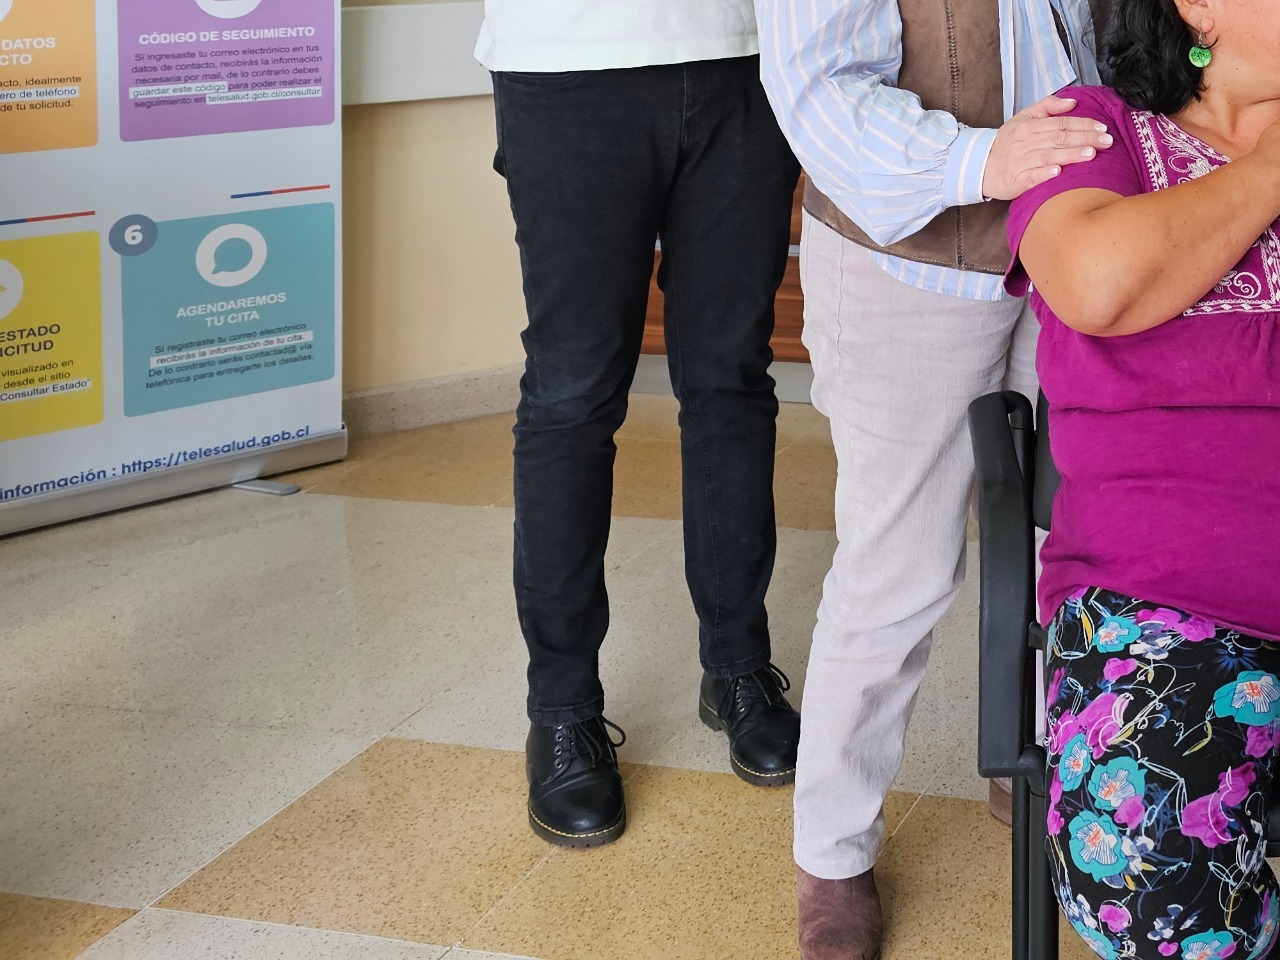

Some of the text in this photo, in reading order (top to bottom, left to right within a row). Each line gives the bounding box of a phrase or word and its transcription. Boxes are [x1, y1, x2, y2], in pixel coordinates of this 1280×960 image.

[138, 26, 315, 44] CÓDIGO DE SEGUIMIENTO
[1, 37, 56, 51] DATOS
[0, 53, 32, 66] CTO
[134, 53, 144, 61] Si
[147, 51, 196, 62] ingresaste
[210, 49, 239, 57] correo
[242, 46, 289, 55] electrónico
[131, 65, 158, 73] datos
[220, 59, 258, 68] recibirás
[272, 55, 322, 64] información
[25, 76, 82, 86] idealmente
[135, 75, 181, 85] necesaria
[184, 74, 199, 83] por
[251, 68, 289, 77] contrario
[20, 90, 32, 98] de
[36, 88, 77, 97] teléfono
[133, 87, 170, 97] guardar
[195, 84, 225, 93] código
[228, 82, 248, 91] para
[251, 80, 276, 89] poder
[0, 99, 74, 112] de tu solicitud.
[134, 98, 191, 109] seguimiento
[124, 224, 143, 245] 6
[176, 292, 287, 318] AGENDAREMOS
[205, 310, 260, 328] TU CITA
[228, 332, 258, 342] correo
[260, 323, 307, 337] electrónico
[0, 340, 54, 358] ICITUD
[209, 341, 261, 356] información
[263, 338, 275, 347] de
[1, 360, 74, 377] visualizado en
[148, 368, 163, 378] De
[164, 366, 173, 374] lo
[193, 371, 214, 382] para
[3, 372, 71, 389] desde el sitio
[0, 469, 107, 500] información
[121, 425, 309, 475] https://telesalud.gob.cl
